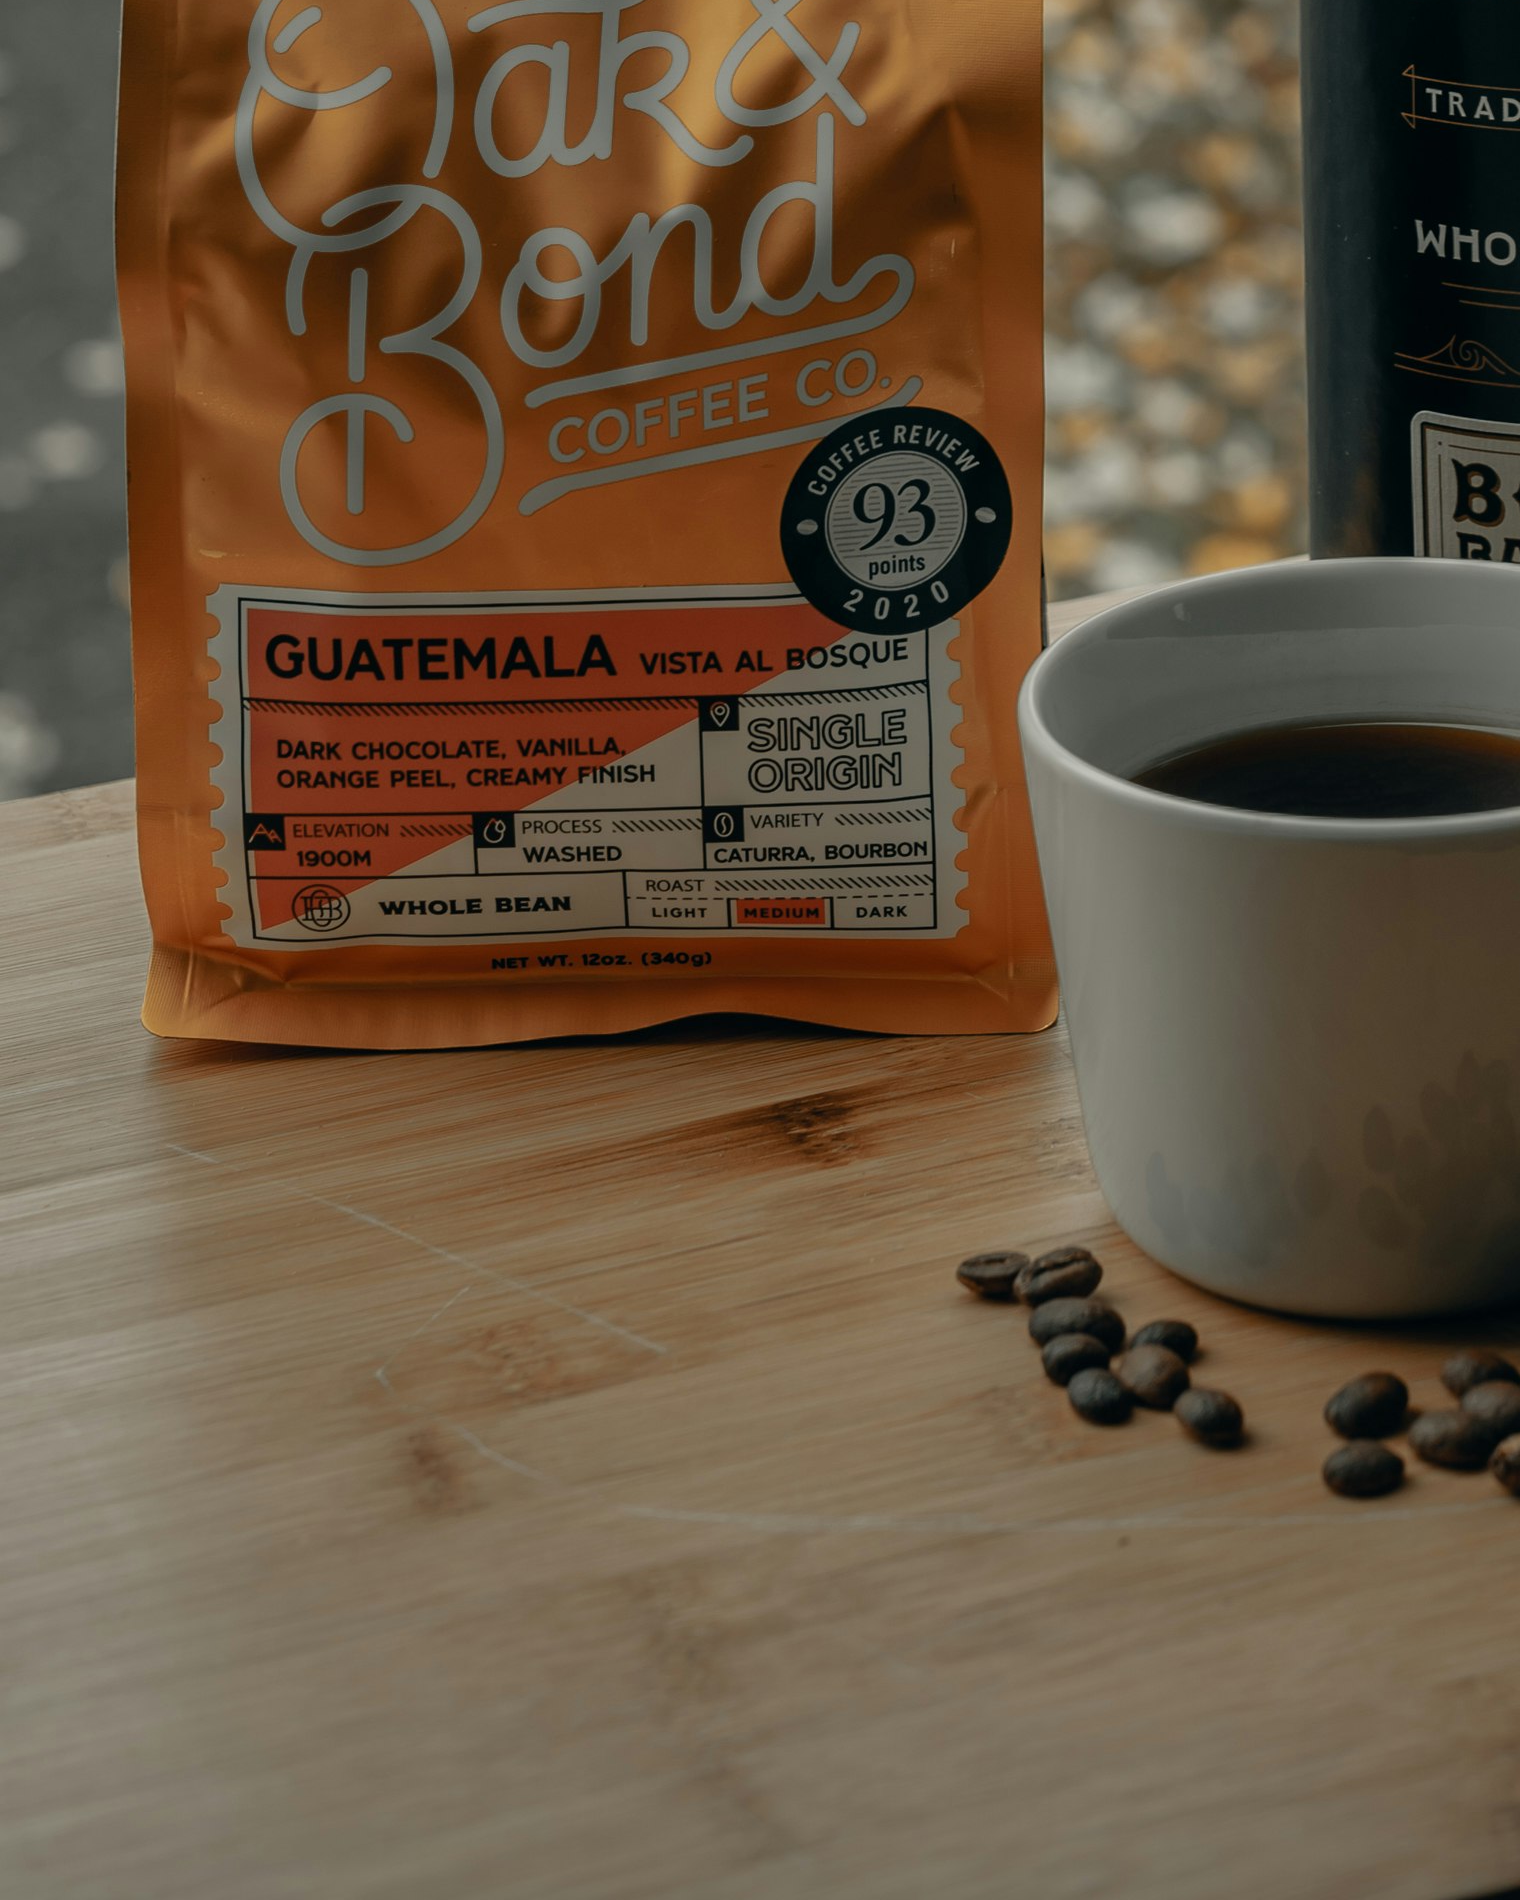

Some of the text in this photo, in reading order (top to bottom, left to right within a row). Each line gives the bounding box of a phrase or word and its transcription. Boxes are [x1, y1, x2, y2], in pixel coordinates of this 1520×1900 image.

[279, 111, 916, 568] Bond
[547, 348, 892, 465] COFFEE CO.
[807, 424, 981, 496] COFFEE REVIEW
[853, 478, 936, 551] 93
[868, 554, 926, 580] points
[842, 580, 949, 621] 2020
[265, 634, 909, 681] GUATEMALA VISTA AL BOSQUE
[747, 708, 908, 754] SINGLE
[276, 737, 627, 761] DARK CHOCOLATE, VANILLA,
[276, 764, 656, 790] ORANGE PEEL, CREAMY FINISH
[747, 752, 903, 794] ORIGIN
[292, 823, 390, 839] ELEVATION
[521, 818, 603, 835] PROCESS
[750, 812, 824, 829] VARIETY
[297, 849, 372, 868] 1900M
[522, 845, 623, 863] WASHED
[713, 840, 928, 864] CATURRA, BOURBON
[645, 879, 705, 893] ROAST
[378, 895, 572, 916] WHOLE BEAN
[651, 905, 908, 920] LIGHT MEDIUM DARK
[491, 951, 713, 969] NET WT. 12oz. (340g)
